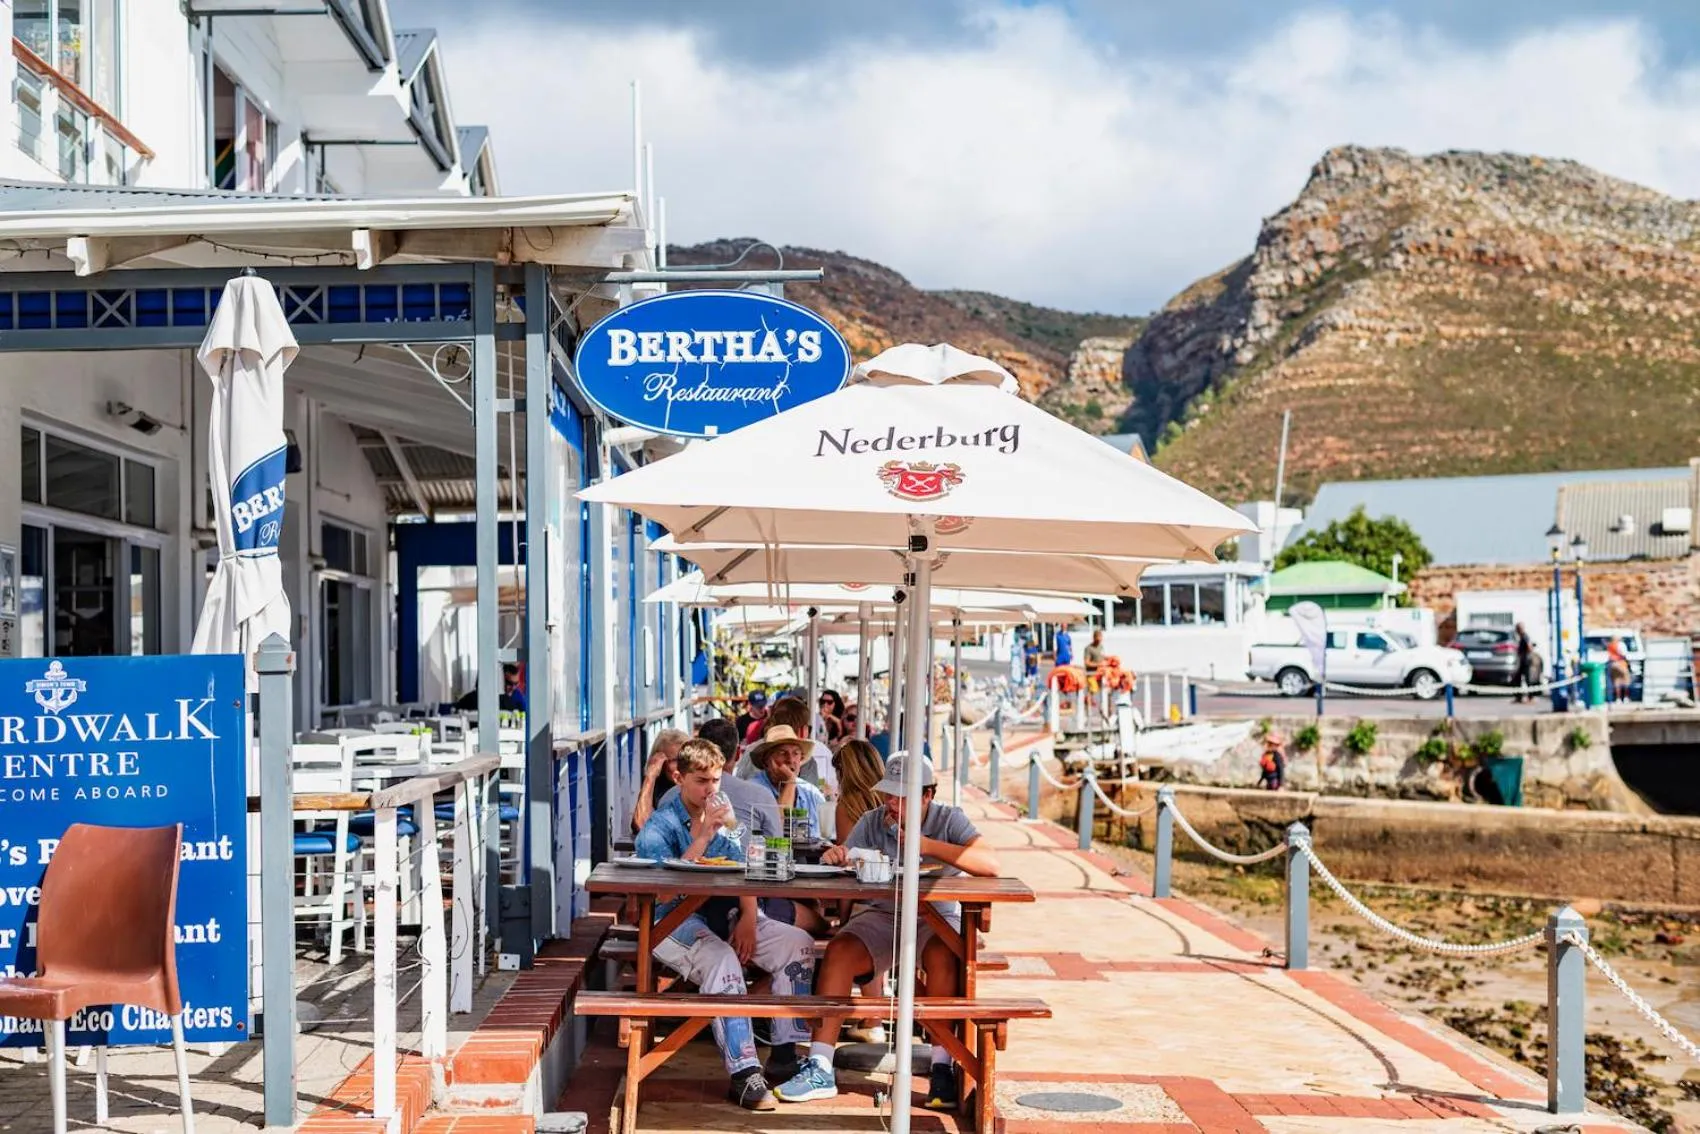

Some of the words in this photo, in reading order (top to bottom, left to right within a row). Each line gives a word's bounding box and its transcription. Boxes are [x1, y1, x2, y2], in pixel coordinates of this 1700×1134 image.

[607, 329, 822, 366] BERTHA'S
[643, 373, 784, 401] Restaurant
[813, 424, 1020, 459] Nederburg
[75, 785, 168, 799] ABOARD
[69, 1006, 114, 1032] Eco
[122, 1002, 233, 1031] Chaters
